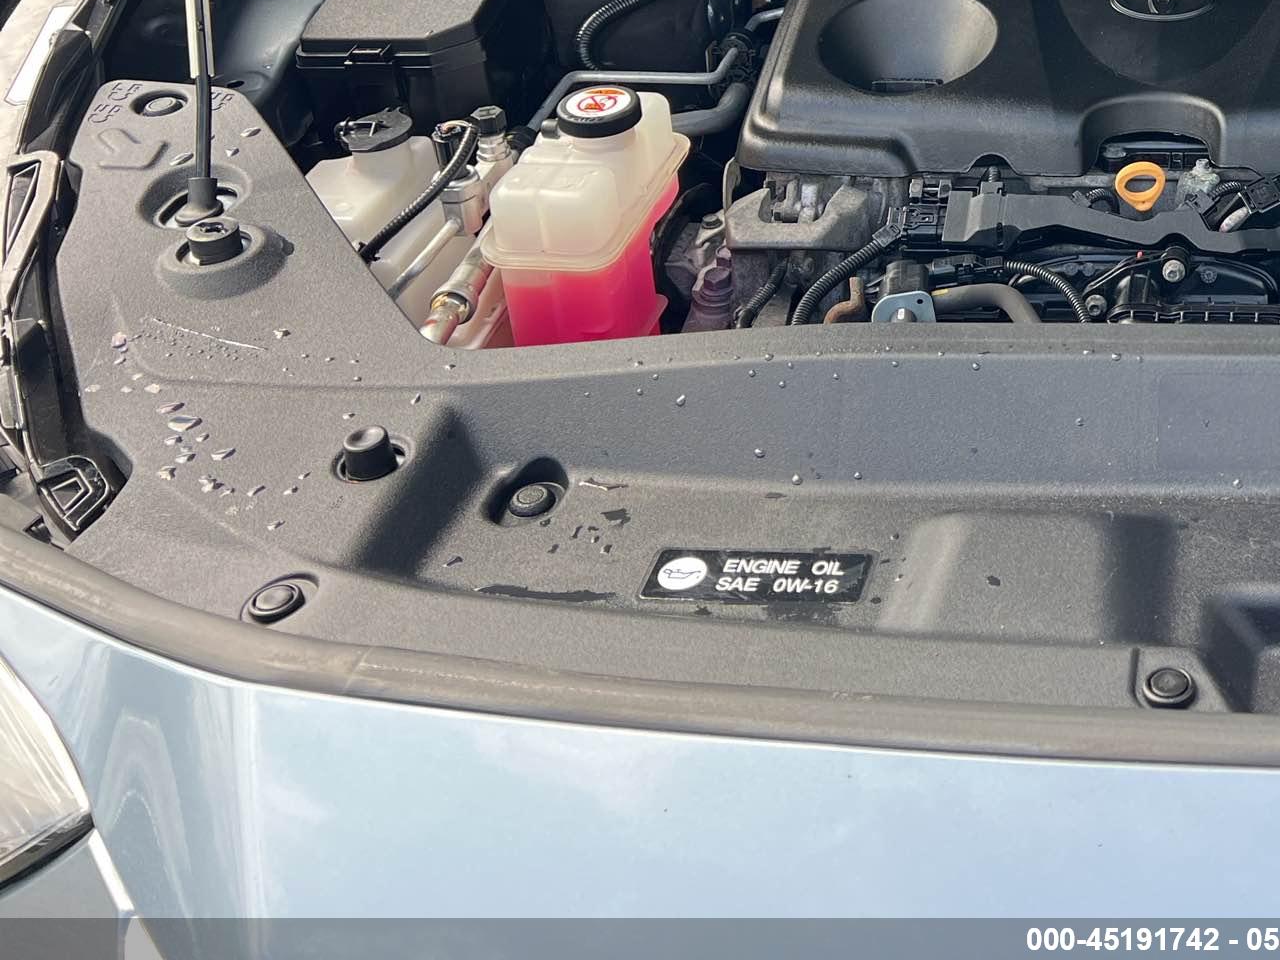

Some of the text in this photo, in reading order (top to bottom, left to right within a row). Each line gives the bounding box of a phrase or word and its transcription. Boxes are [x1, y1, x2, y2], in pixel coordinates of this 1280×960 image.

[723, 558, 845, 576] ENGINE OIL
[716, 577, 839, 593] SAE 0W-16
